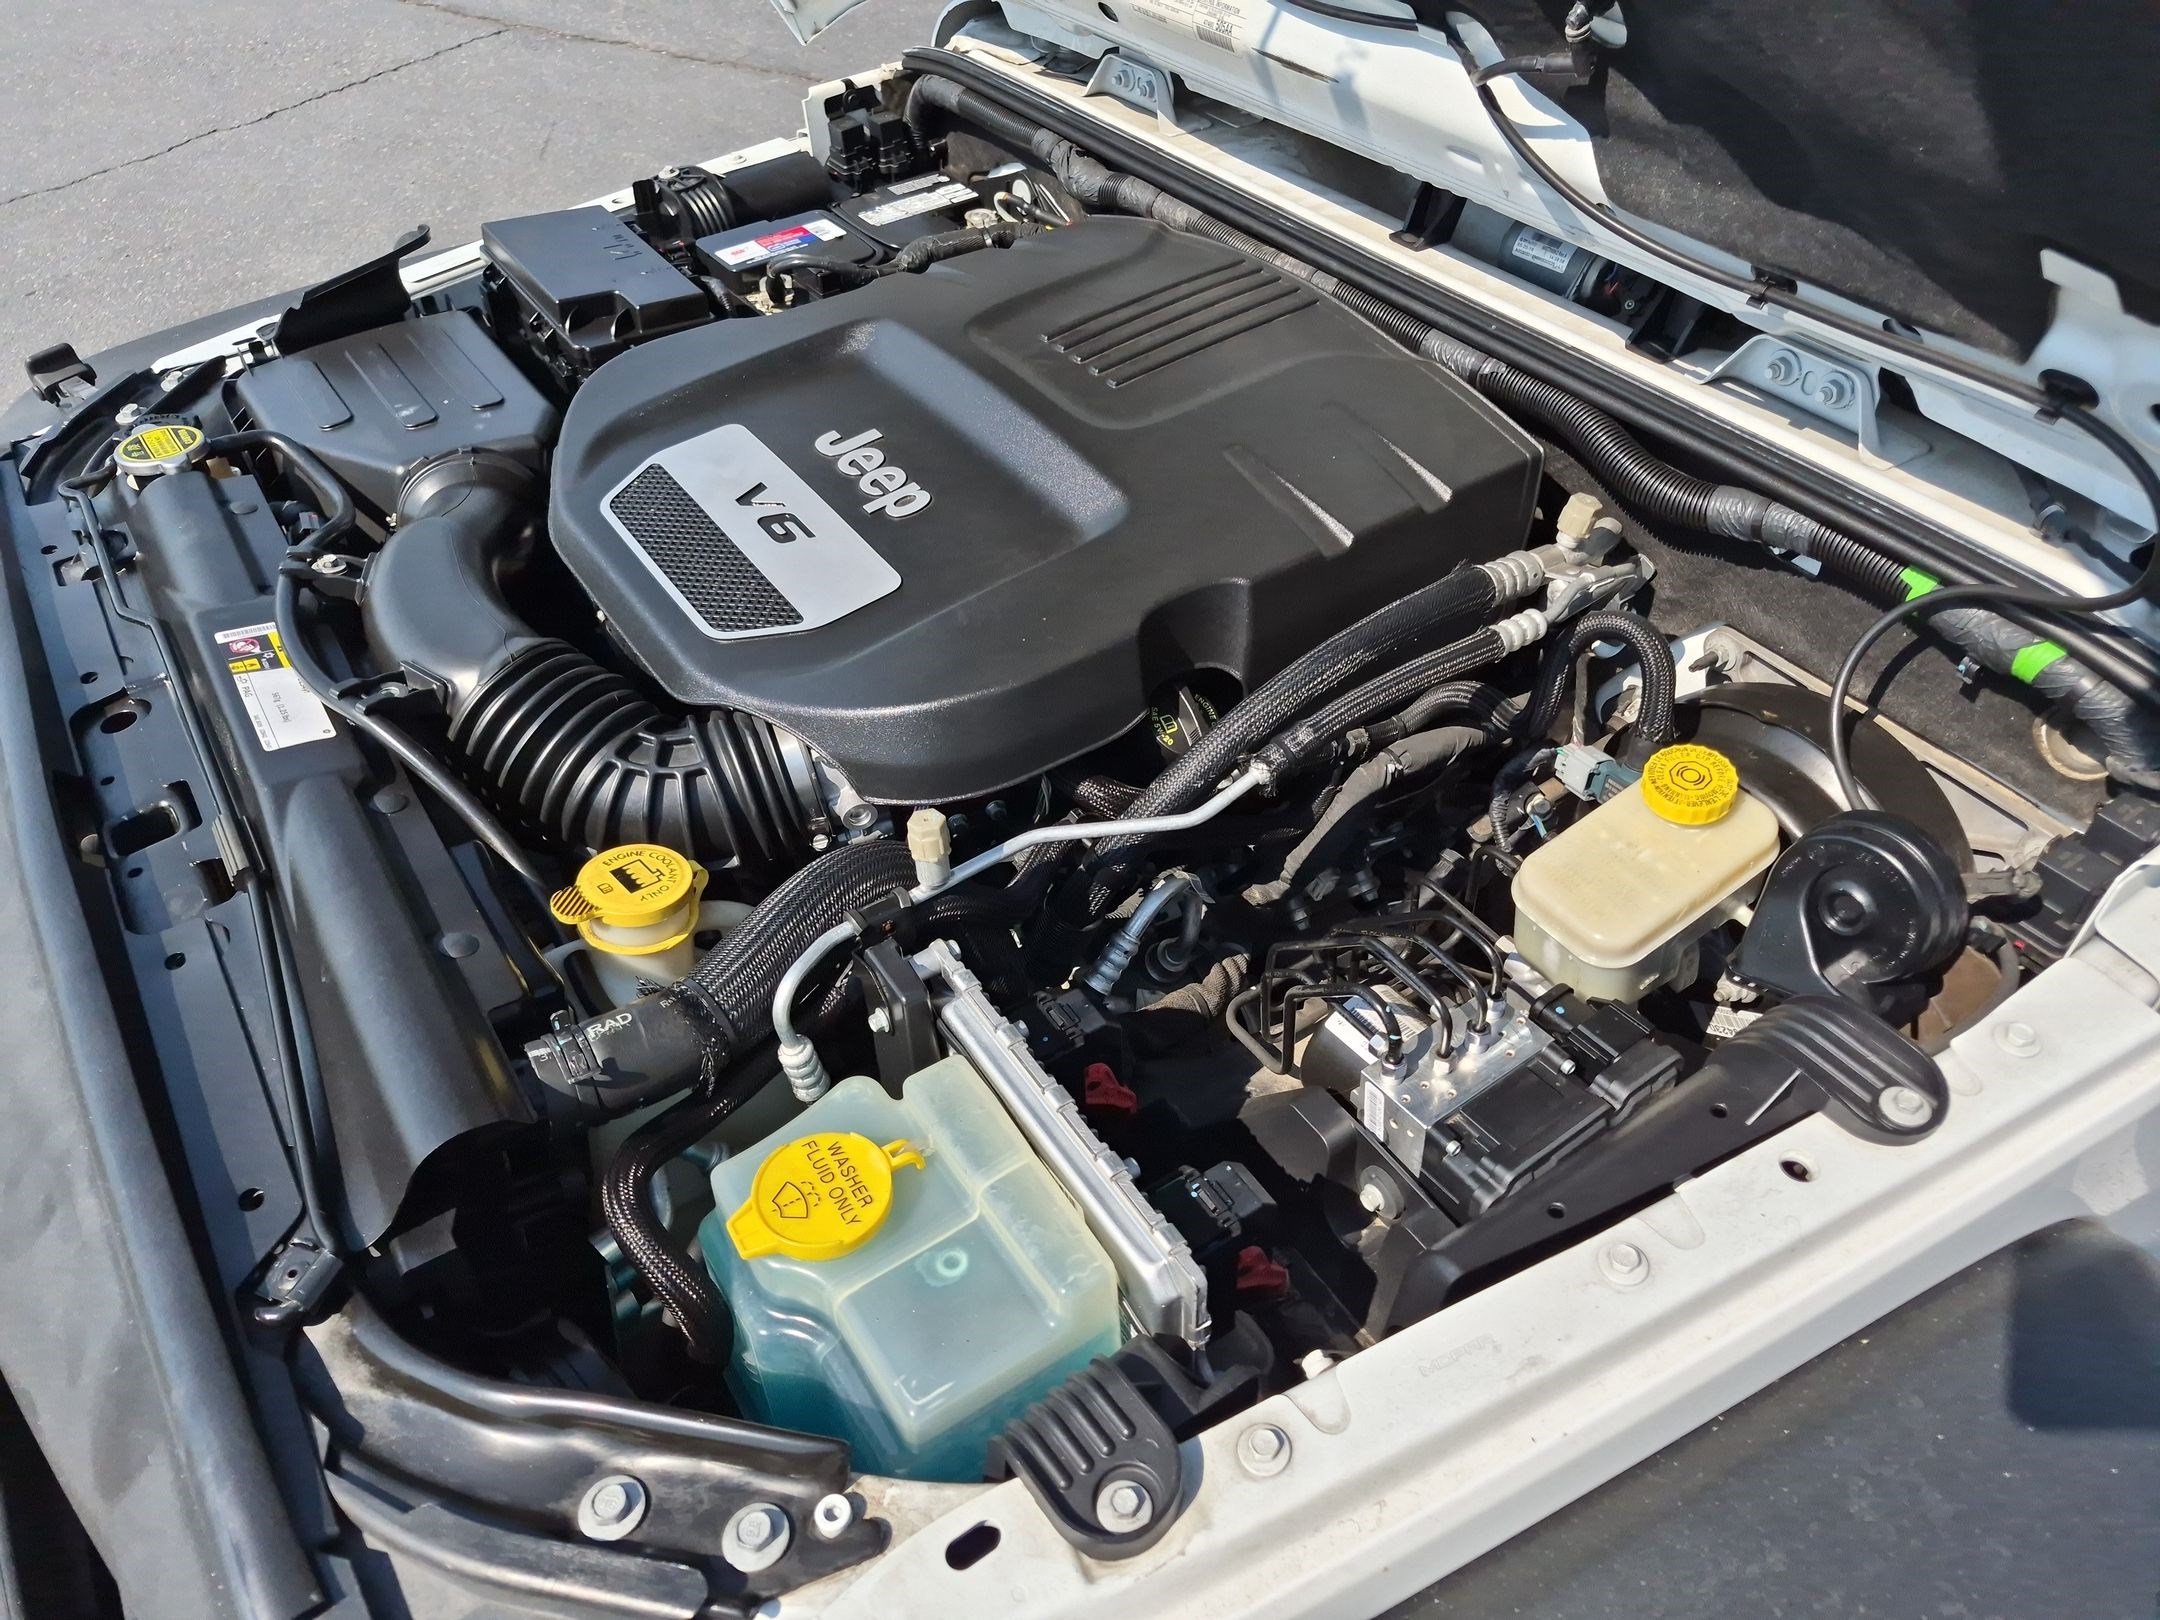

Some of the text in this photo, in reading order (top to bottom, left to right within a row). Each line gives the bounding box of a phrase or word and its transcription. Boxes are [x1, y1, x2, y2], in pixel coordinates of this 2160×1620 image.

[814, 428, 933, 519] Jeep
[734, 482, 816, 544] V6
[241, 685, 253, 698] PAG
[1194, 693, 1217, 720] ENGINE
[602, 850, 678, 902] ENGINE COOLANT ONLY
[586, 1012, 633, 1037] RAD
[801, 1140, 862, 1225] FLUID ONLY
[827, 1141, 873, 1208] WASHER
